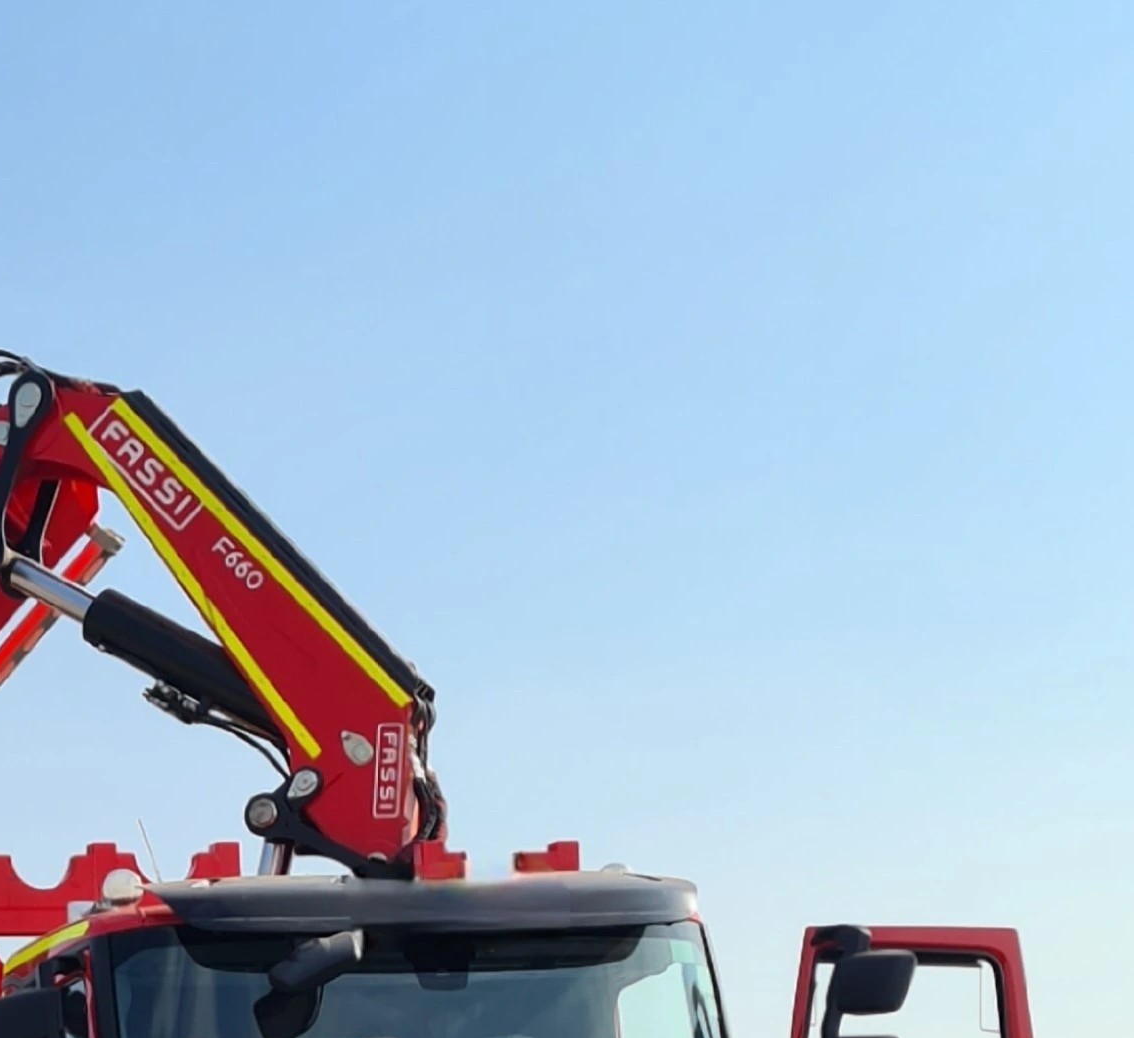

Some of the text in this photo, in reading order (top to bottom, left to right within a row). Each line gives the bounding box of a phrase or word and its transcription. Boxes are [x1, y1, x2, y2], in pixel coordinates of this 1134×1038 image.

[100, 419, 193, 516] FASSI
[211, 536, 264, 590] F660
[379, 730, 399, 812] FASSI
